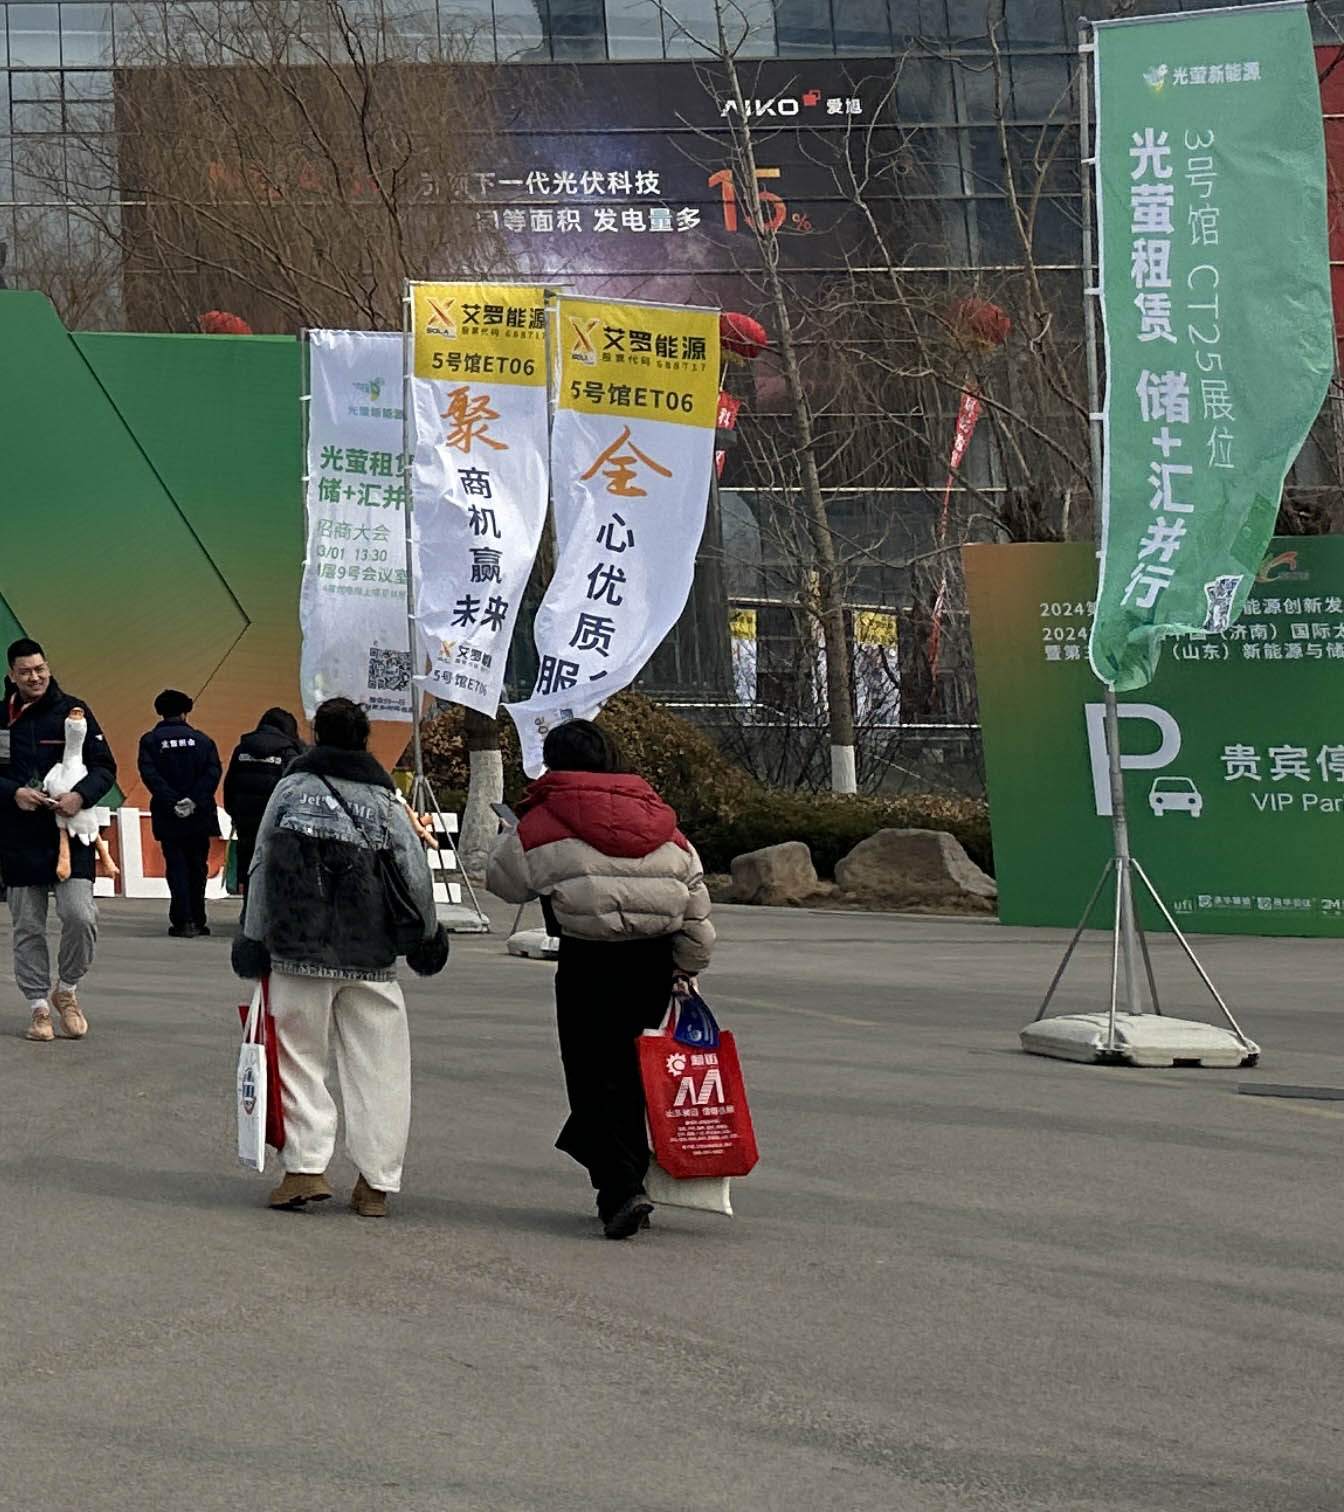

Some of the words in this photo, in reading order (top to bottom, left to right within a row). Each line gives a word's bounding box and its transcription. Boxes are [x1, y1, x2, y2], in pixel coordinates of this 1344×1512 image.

[593, 206, 702, 233] 发电量多
[1127, 128, 1178, 345] 光萤租赁
[462, 303, 545, 329] 艾罗能源
[603, 326, 707, 360] 艾罗能源
[431, 352, 535, 376] 5号馆ET06
[570, 380, 694, 413] 5号馆ET06
[1085, 703, 1182, 816] P
[1251, 792, 1293, 812] VIP
[1302, 792, 1344, 813] Par
